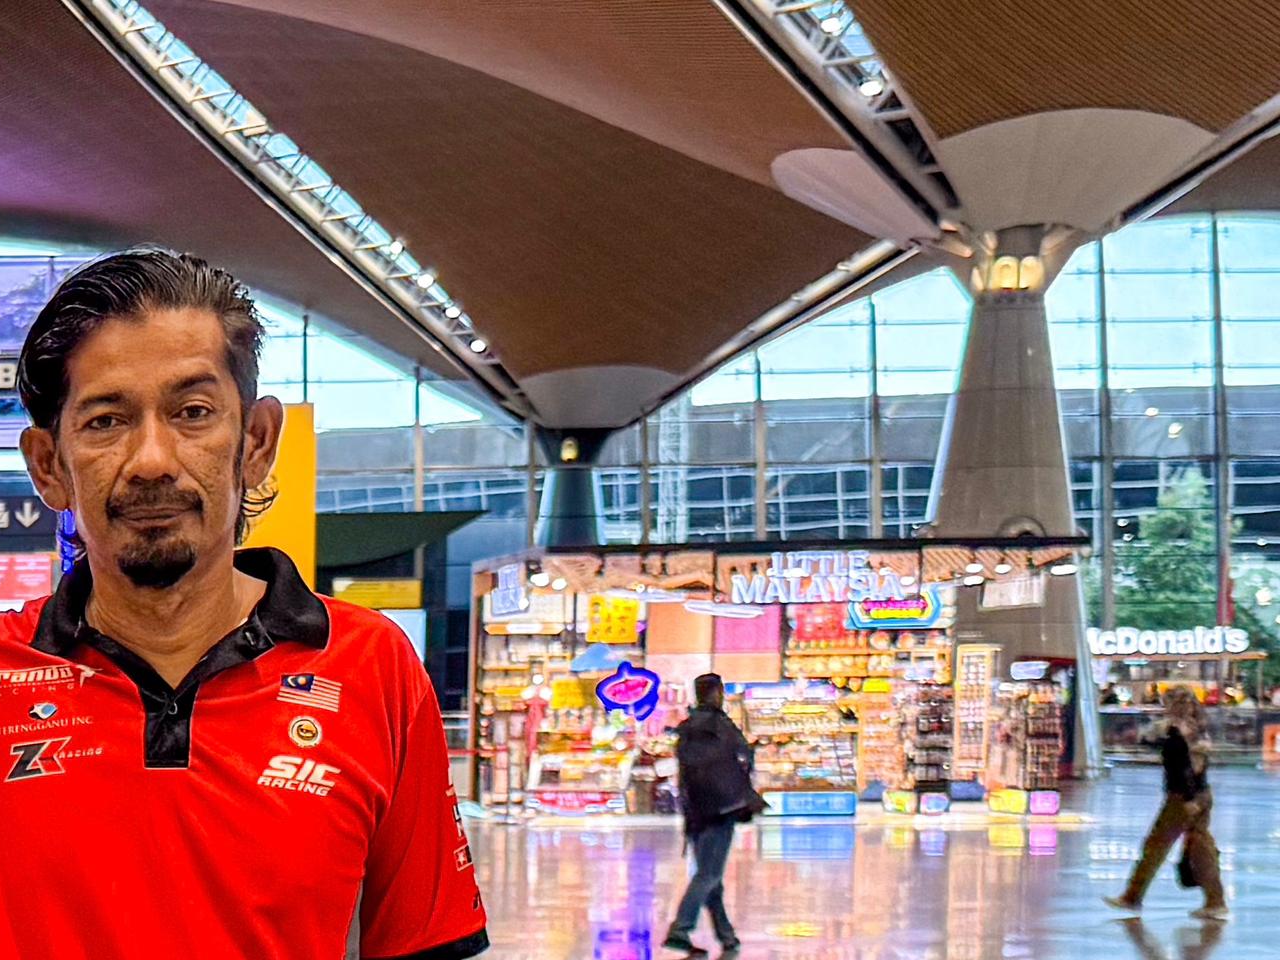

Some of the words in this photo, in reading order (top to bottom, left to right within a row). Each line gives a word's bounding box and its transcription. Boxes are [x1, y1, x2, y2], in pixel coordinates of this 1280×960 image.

[771, 551, 871, 577] LITTLE
[731, 573, 906, 604] MALAYSIA
[71, 716, 94, 727] INC
[262, 755, 341, 787] SIC
[257, 775, 332, 797] RACING
